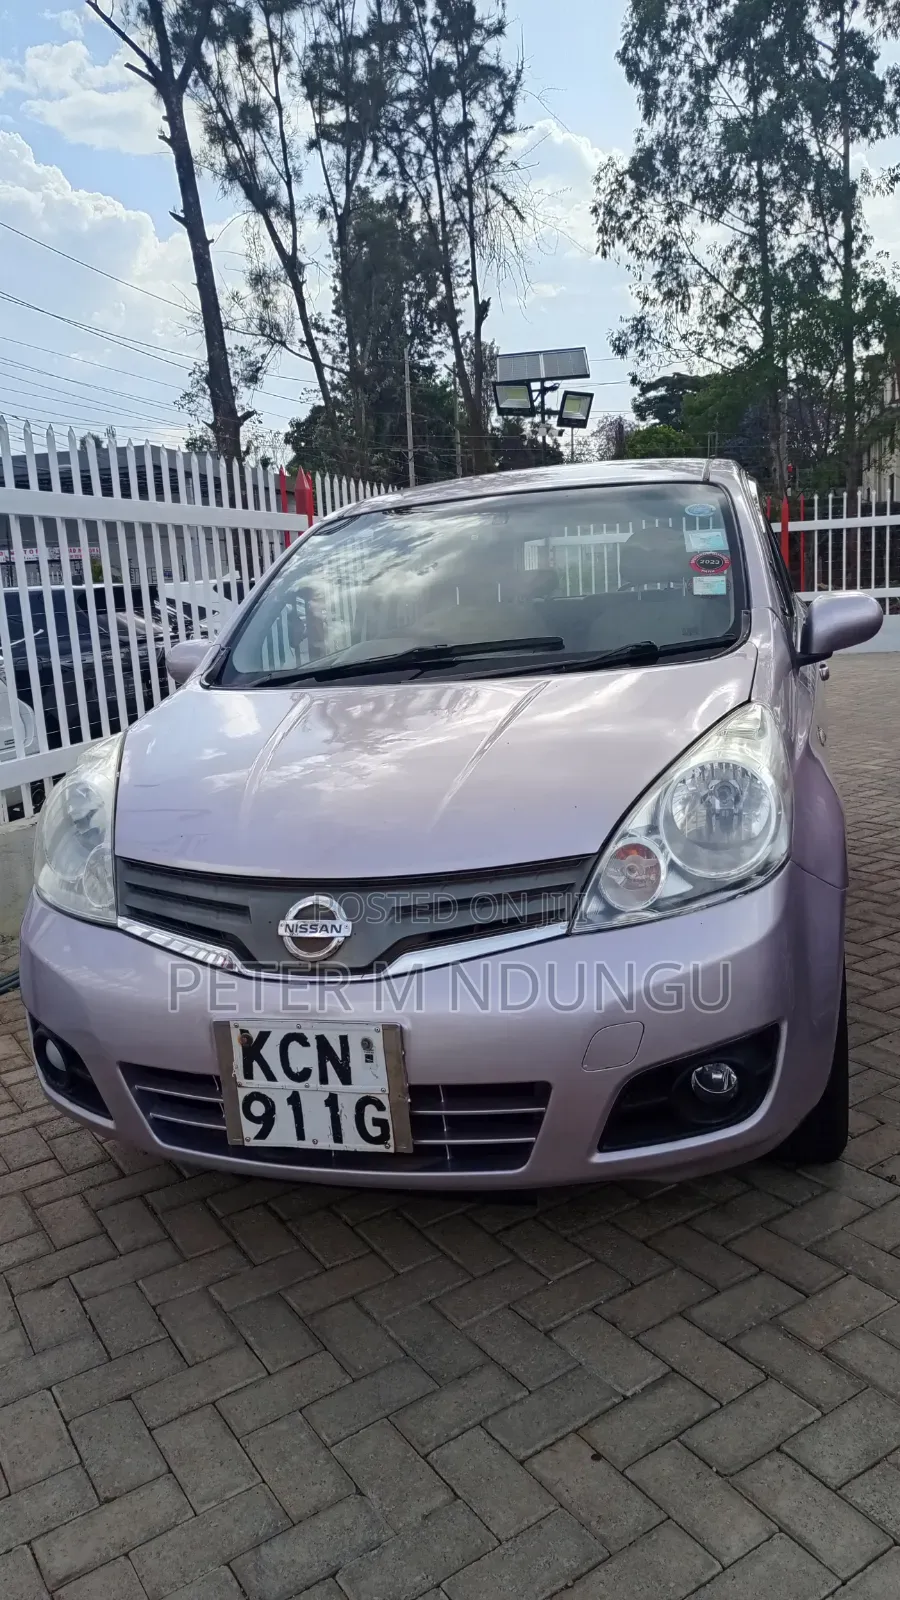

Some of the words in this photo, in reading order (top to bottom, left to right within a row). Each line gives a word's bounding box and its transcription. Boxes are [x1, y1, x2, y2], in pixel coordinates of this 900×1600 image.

[284, 923, 343, 936] NISSAN
[239, 1028, 353, 1086] KCN
[241, 1090, 391, 1146] 911G
